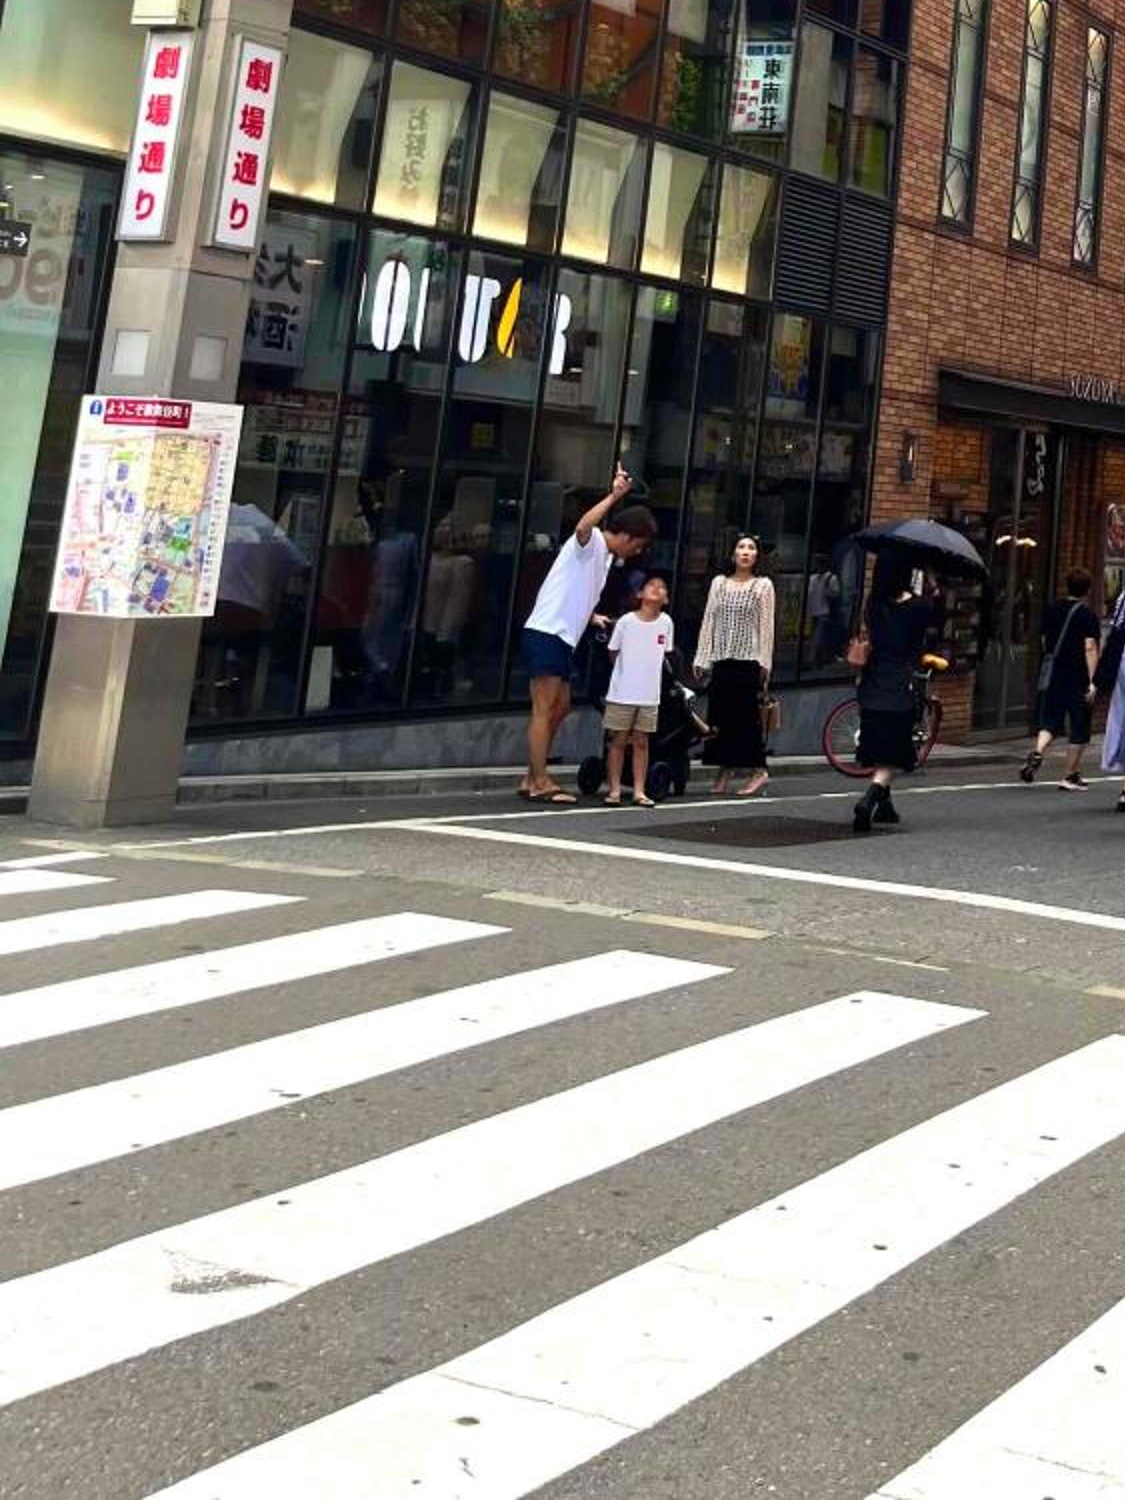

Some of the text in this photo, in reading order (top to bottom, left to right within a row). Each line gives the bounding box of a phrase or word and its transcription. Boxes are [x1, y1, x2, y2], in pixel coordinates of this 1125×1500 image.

[134, 45, 182, 221] 劇場通り
[230, 58, 273, 231] 劇場通り
